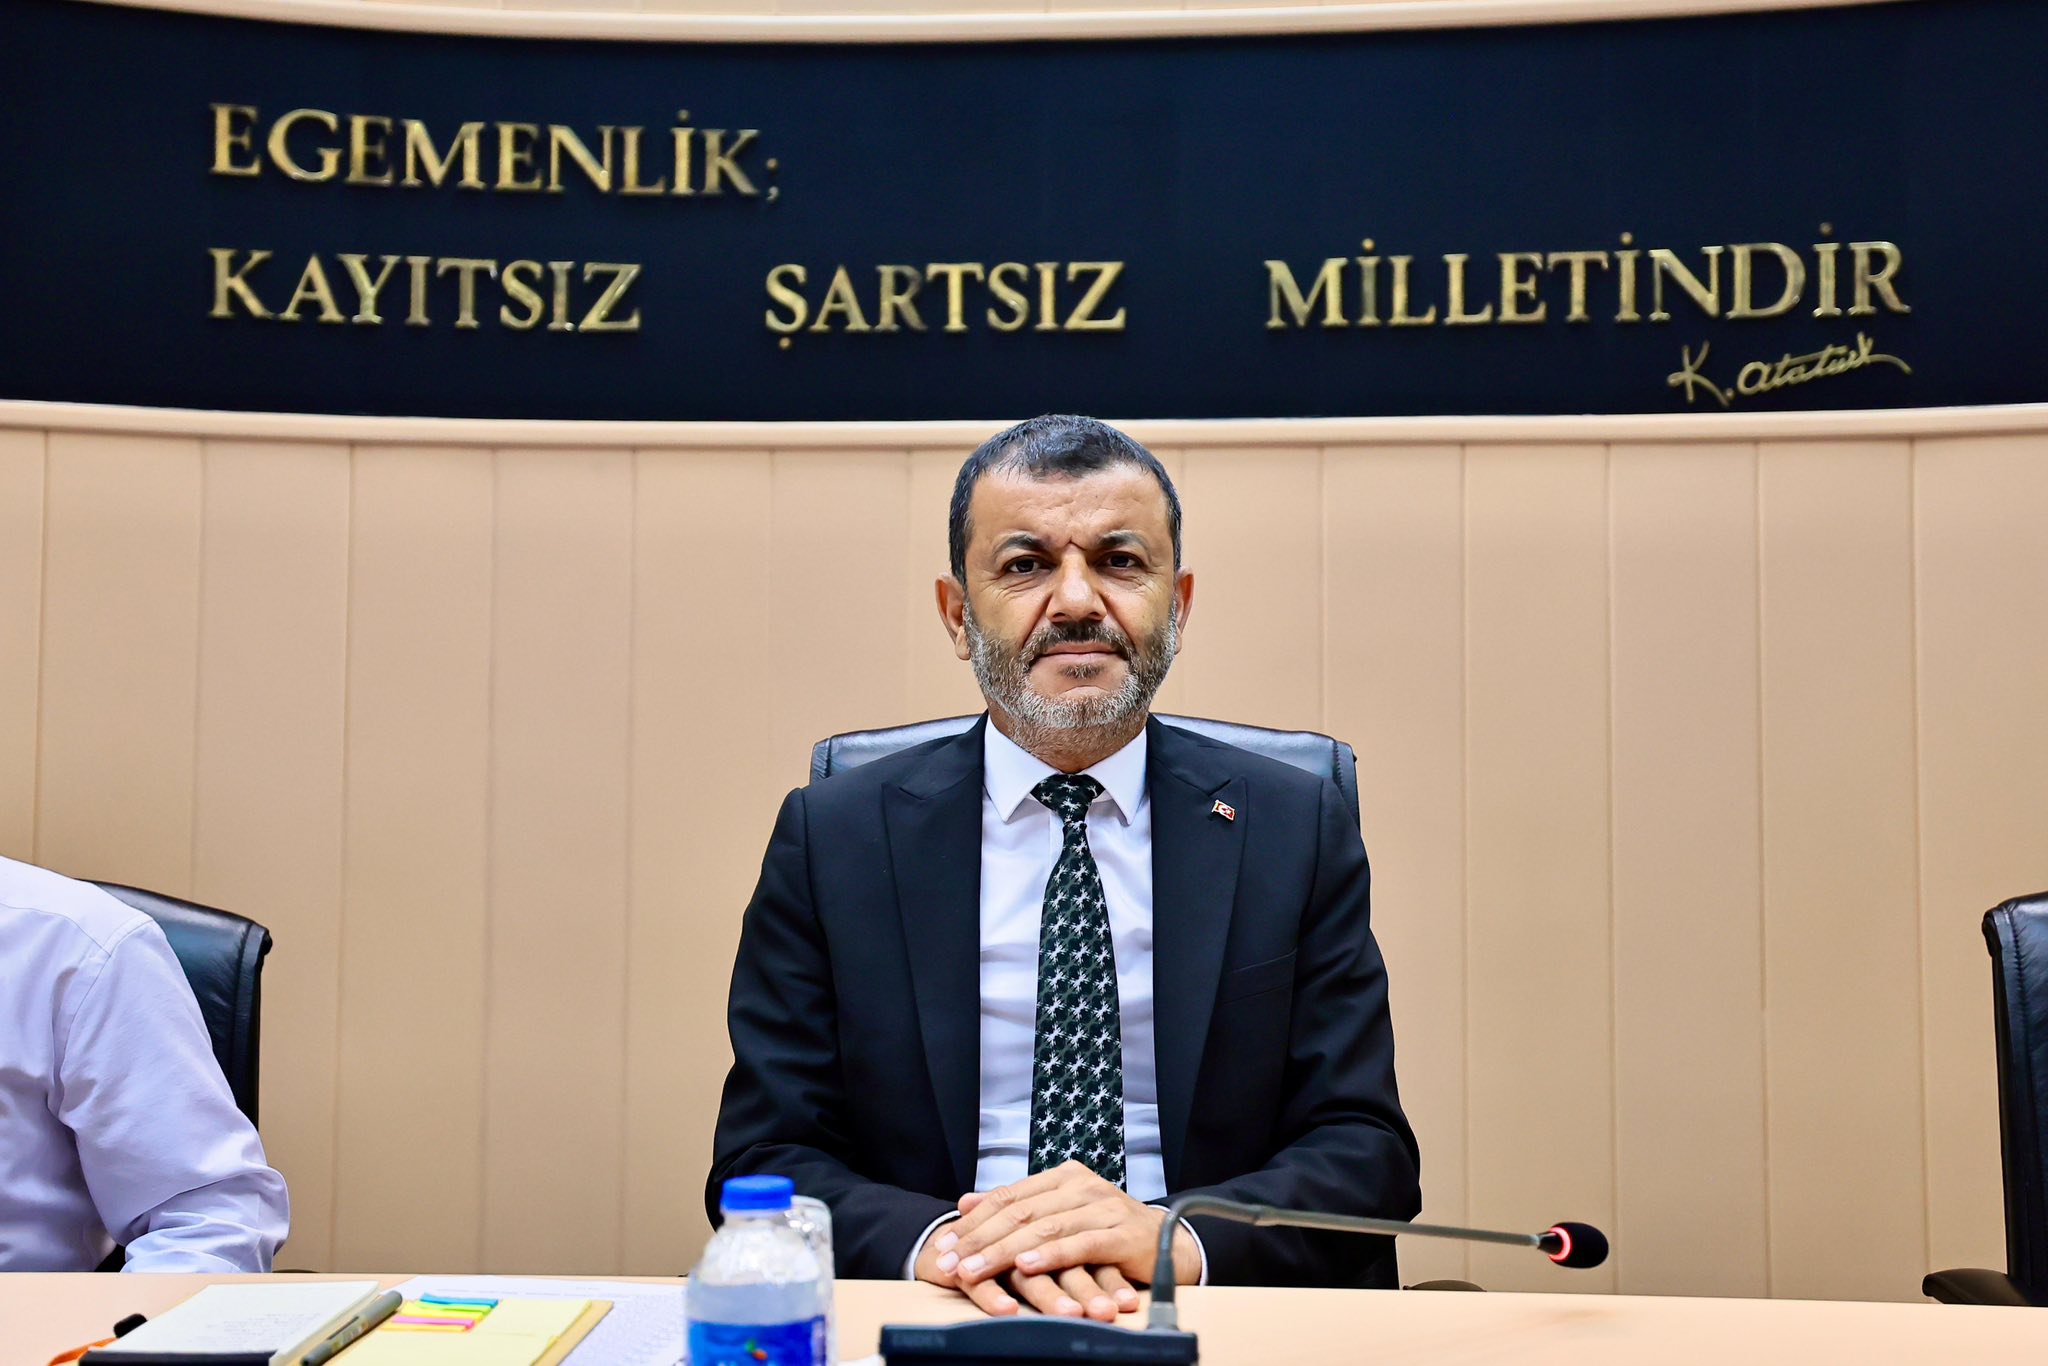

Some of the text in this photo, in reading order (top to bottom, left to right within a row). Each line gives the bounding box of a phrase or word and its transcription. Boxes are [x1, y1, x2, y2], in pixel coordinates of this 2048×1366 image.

[209, 102, 778, 200] EGEMENLİK;
[208, 221, 1912, 349] KAYITSIZ ŞARTSIZ MİLLETİNDİR
[1667, 339, 1734, 407] K.
